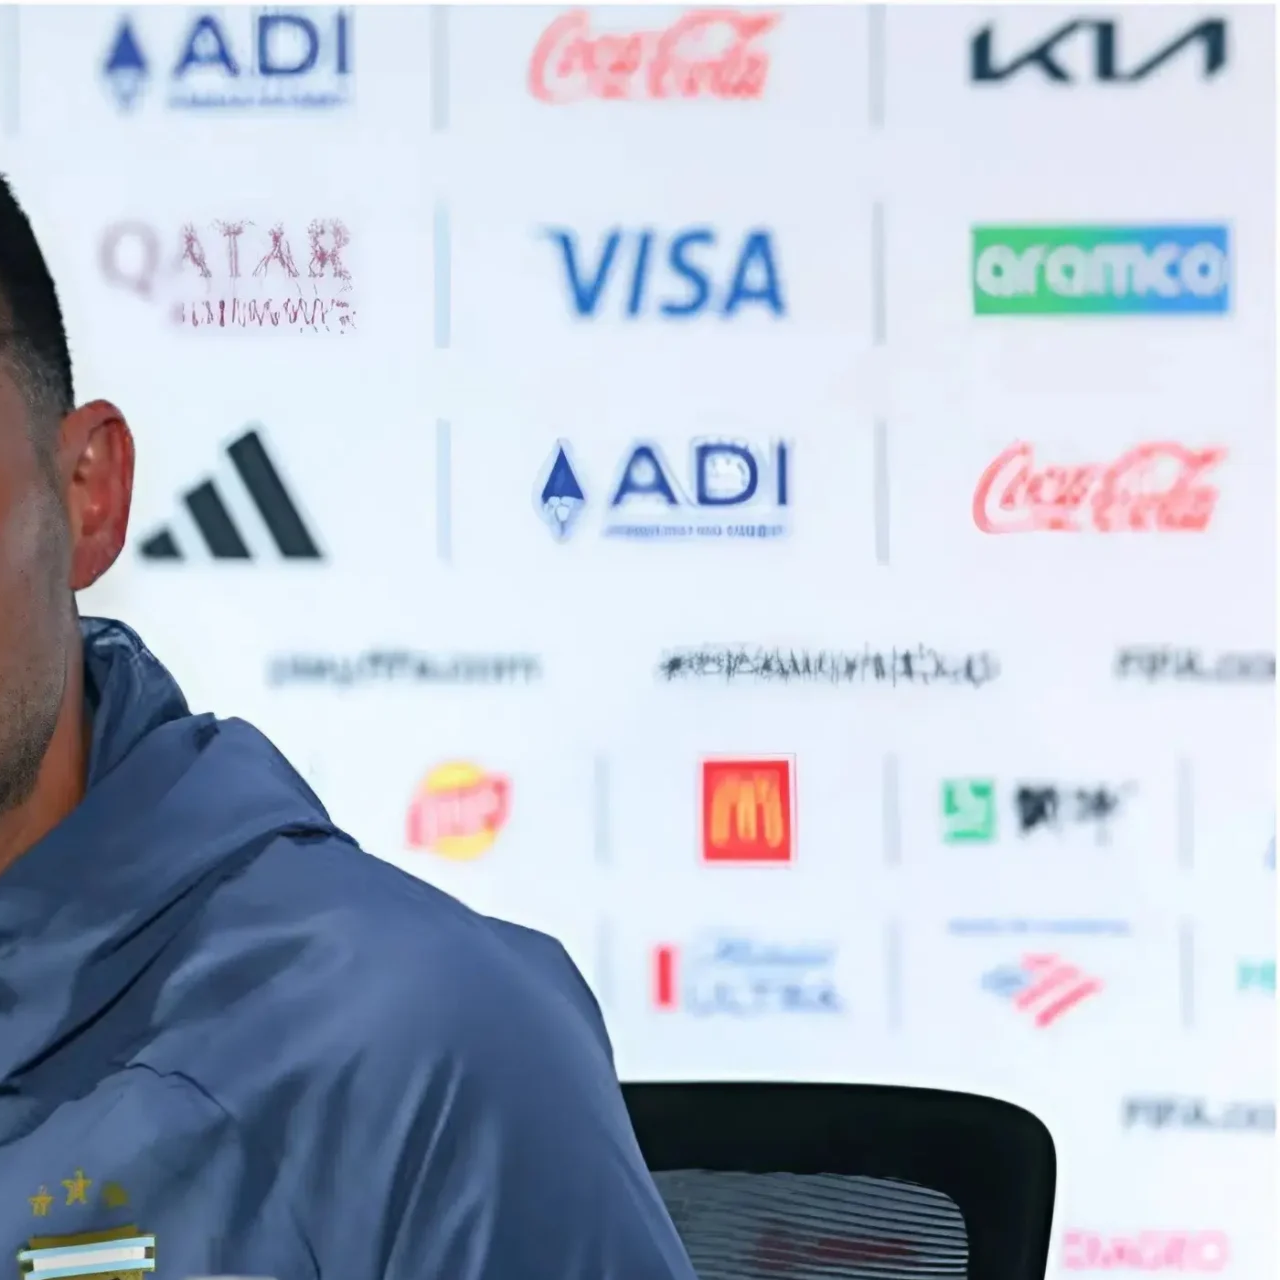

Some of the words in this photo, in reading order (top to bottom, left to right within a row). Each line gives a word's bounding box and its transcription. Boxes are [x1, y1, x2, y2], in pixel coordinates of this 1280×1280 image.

[172, 12, 350, 77] ADI
[546, 226, 787, 318] VISA
[976, 242, 1230, 299] aramco
[610, 442, 788, 507] ADI
